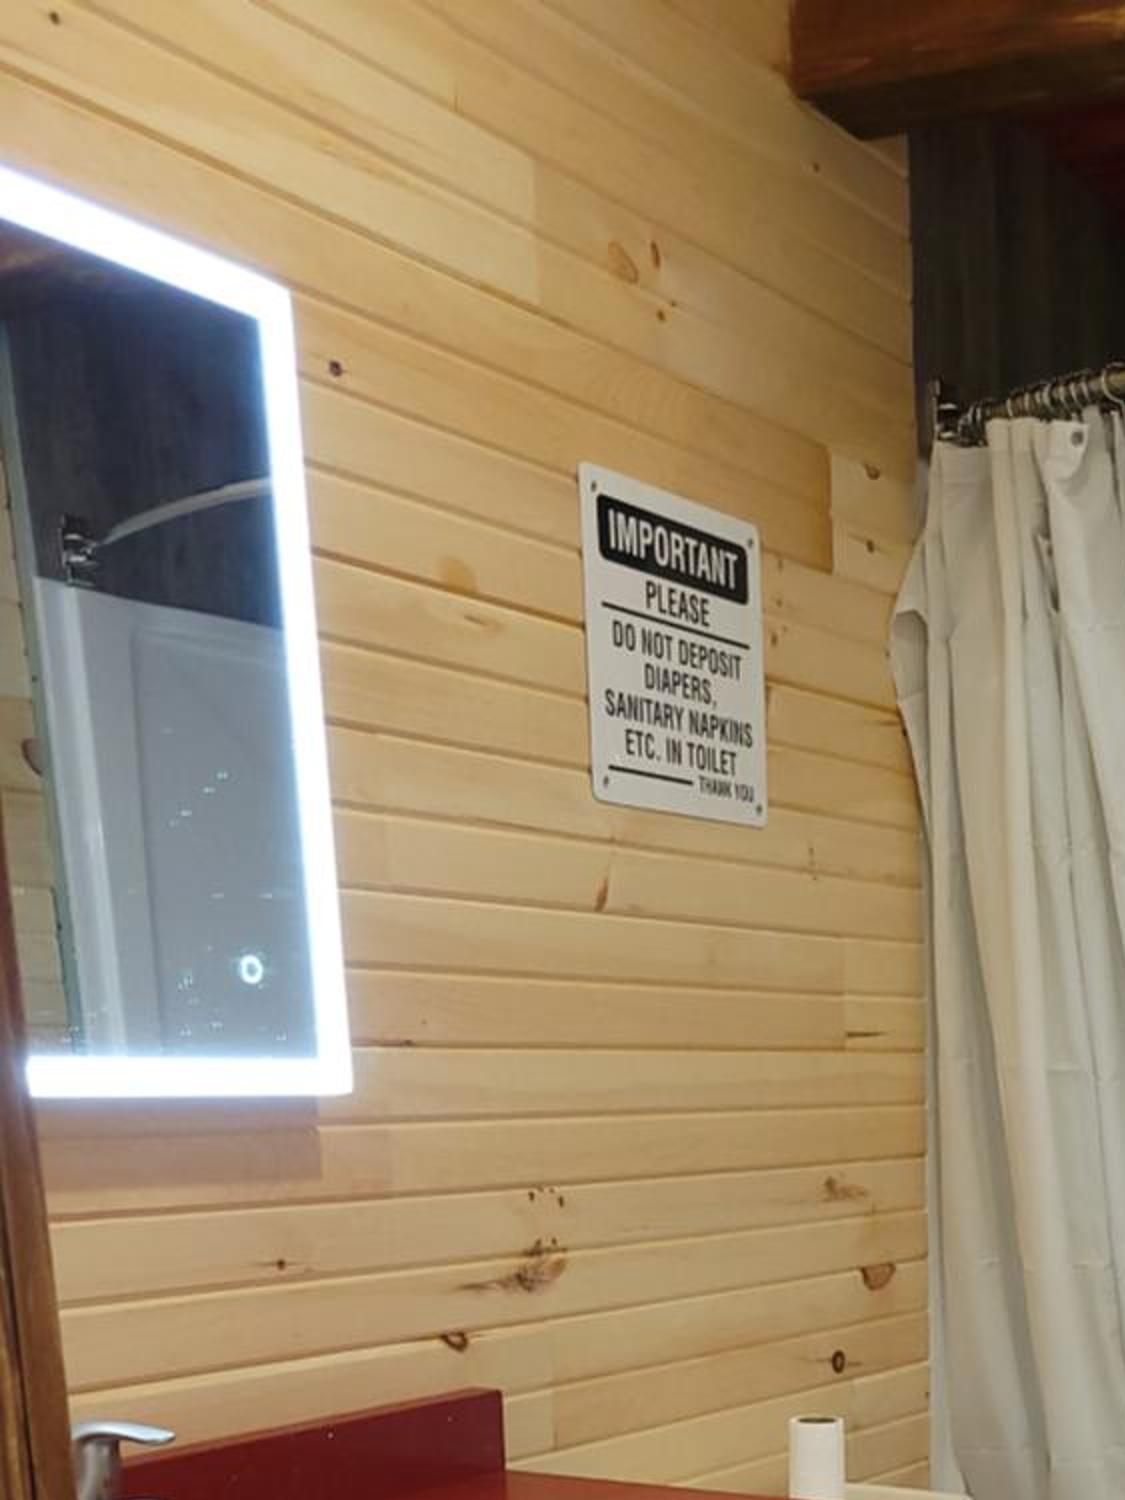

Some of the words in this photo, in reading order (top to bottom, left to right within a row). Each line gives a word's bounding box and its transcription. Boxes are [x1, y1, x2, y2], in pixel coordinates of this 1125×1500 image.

[608, 508, 738, 590] IMPORTANT
[646, 581, 710, 627] PLEASE
[612, 620, 636, 651] DO
[641, 627, 674, 660] NOT
[678, 639, 742, 681] DEPOSIT
[644, 663, 717, 707] DIAPERS,
[604, 689, 685, 728] SANITARY
[689, 713, 753, 749] NAPKINS
[625, 729, 660, 761] ETC.
[666, 738, 681, 766] IN
[686, 742, 737, 776] TOILET
[699, 775, 733, 798] THANK
[735, 782, 755, 802] YOU
